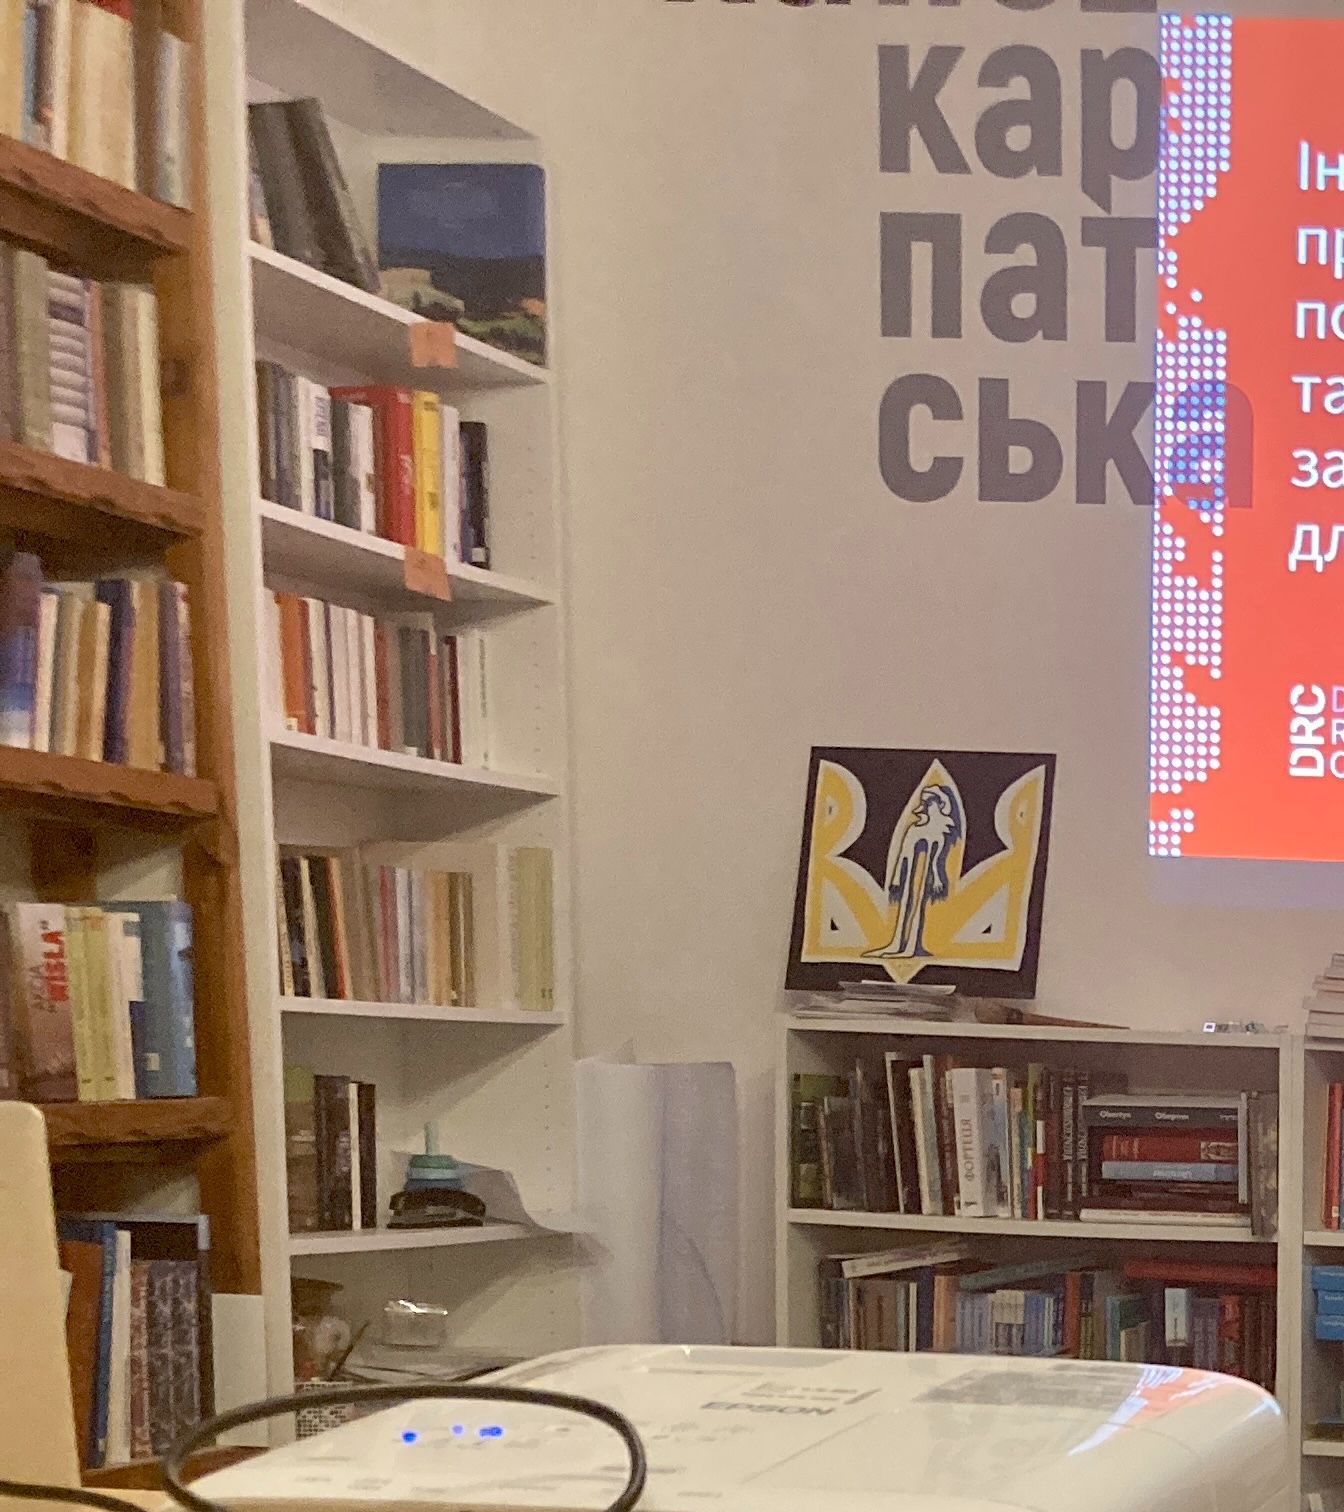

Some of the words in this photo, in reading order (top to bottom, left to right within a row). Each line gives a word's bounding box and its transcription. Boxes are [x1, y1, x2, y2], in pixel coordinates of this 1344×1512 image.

[877, 43, 1167, 215] кар
[879, 211, 1162, 344] пат
[877, 373, 1254, 509] ська
[1289, 684, 1326, 777] DRC
[700, 1401, 835, 1415] EPSON
